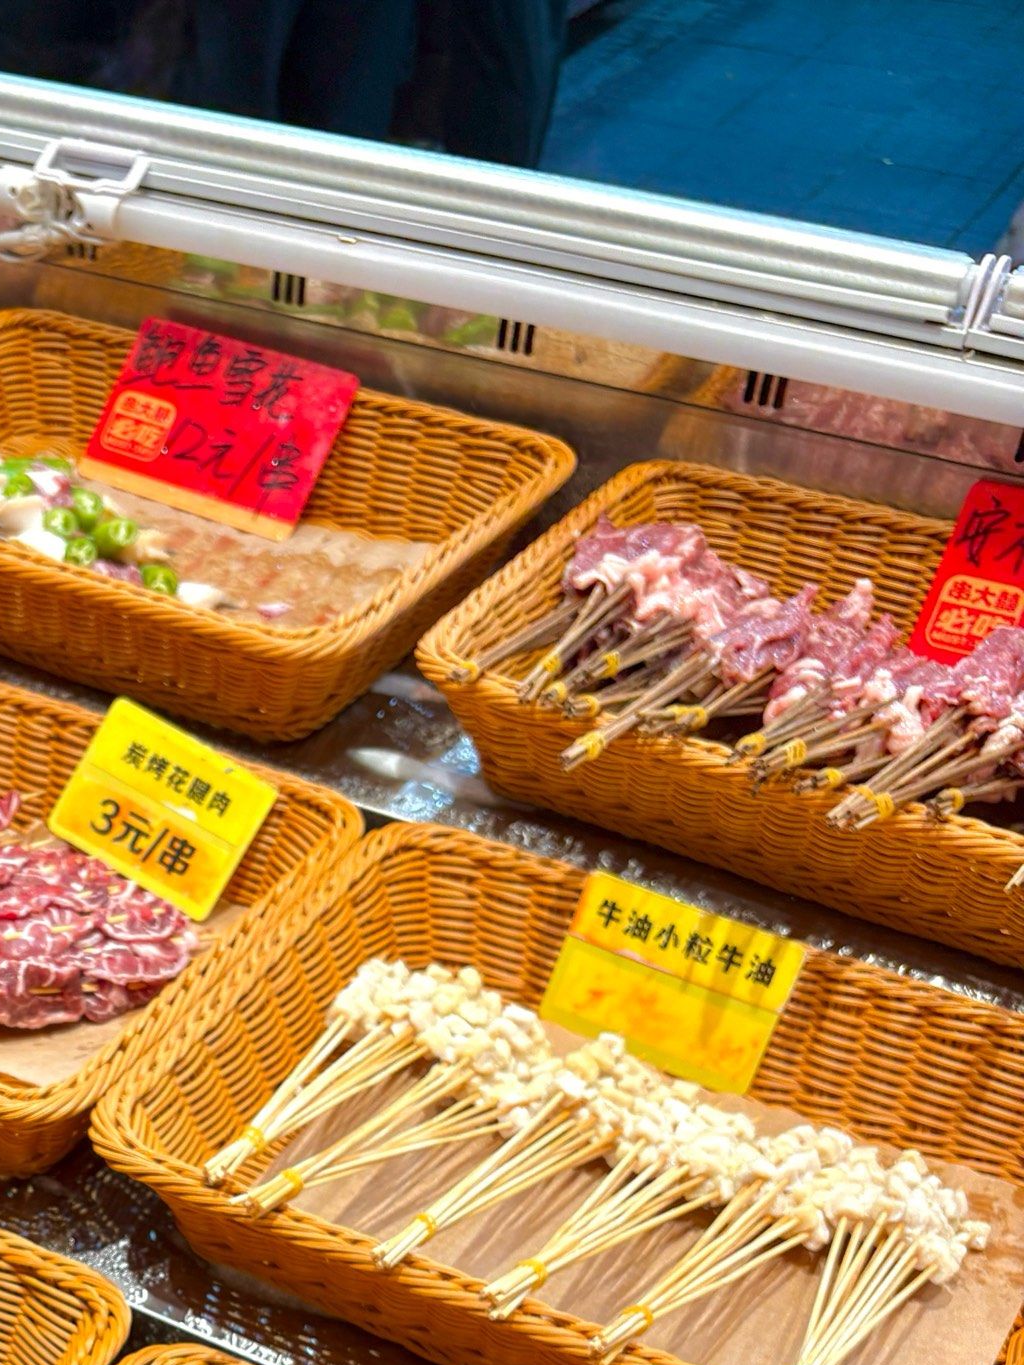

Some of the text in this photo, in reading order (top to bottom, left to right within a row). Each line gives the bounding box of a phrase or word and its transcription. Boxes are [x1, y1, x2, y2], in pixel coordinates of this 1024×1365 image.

[89, 798, 196, 876] 3元/串
[597, 898, 777, 988] 牛油小粒牛油
